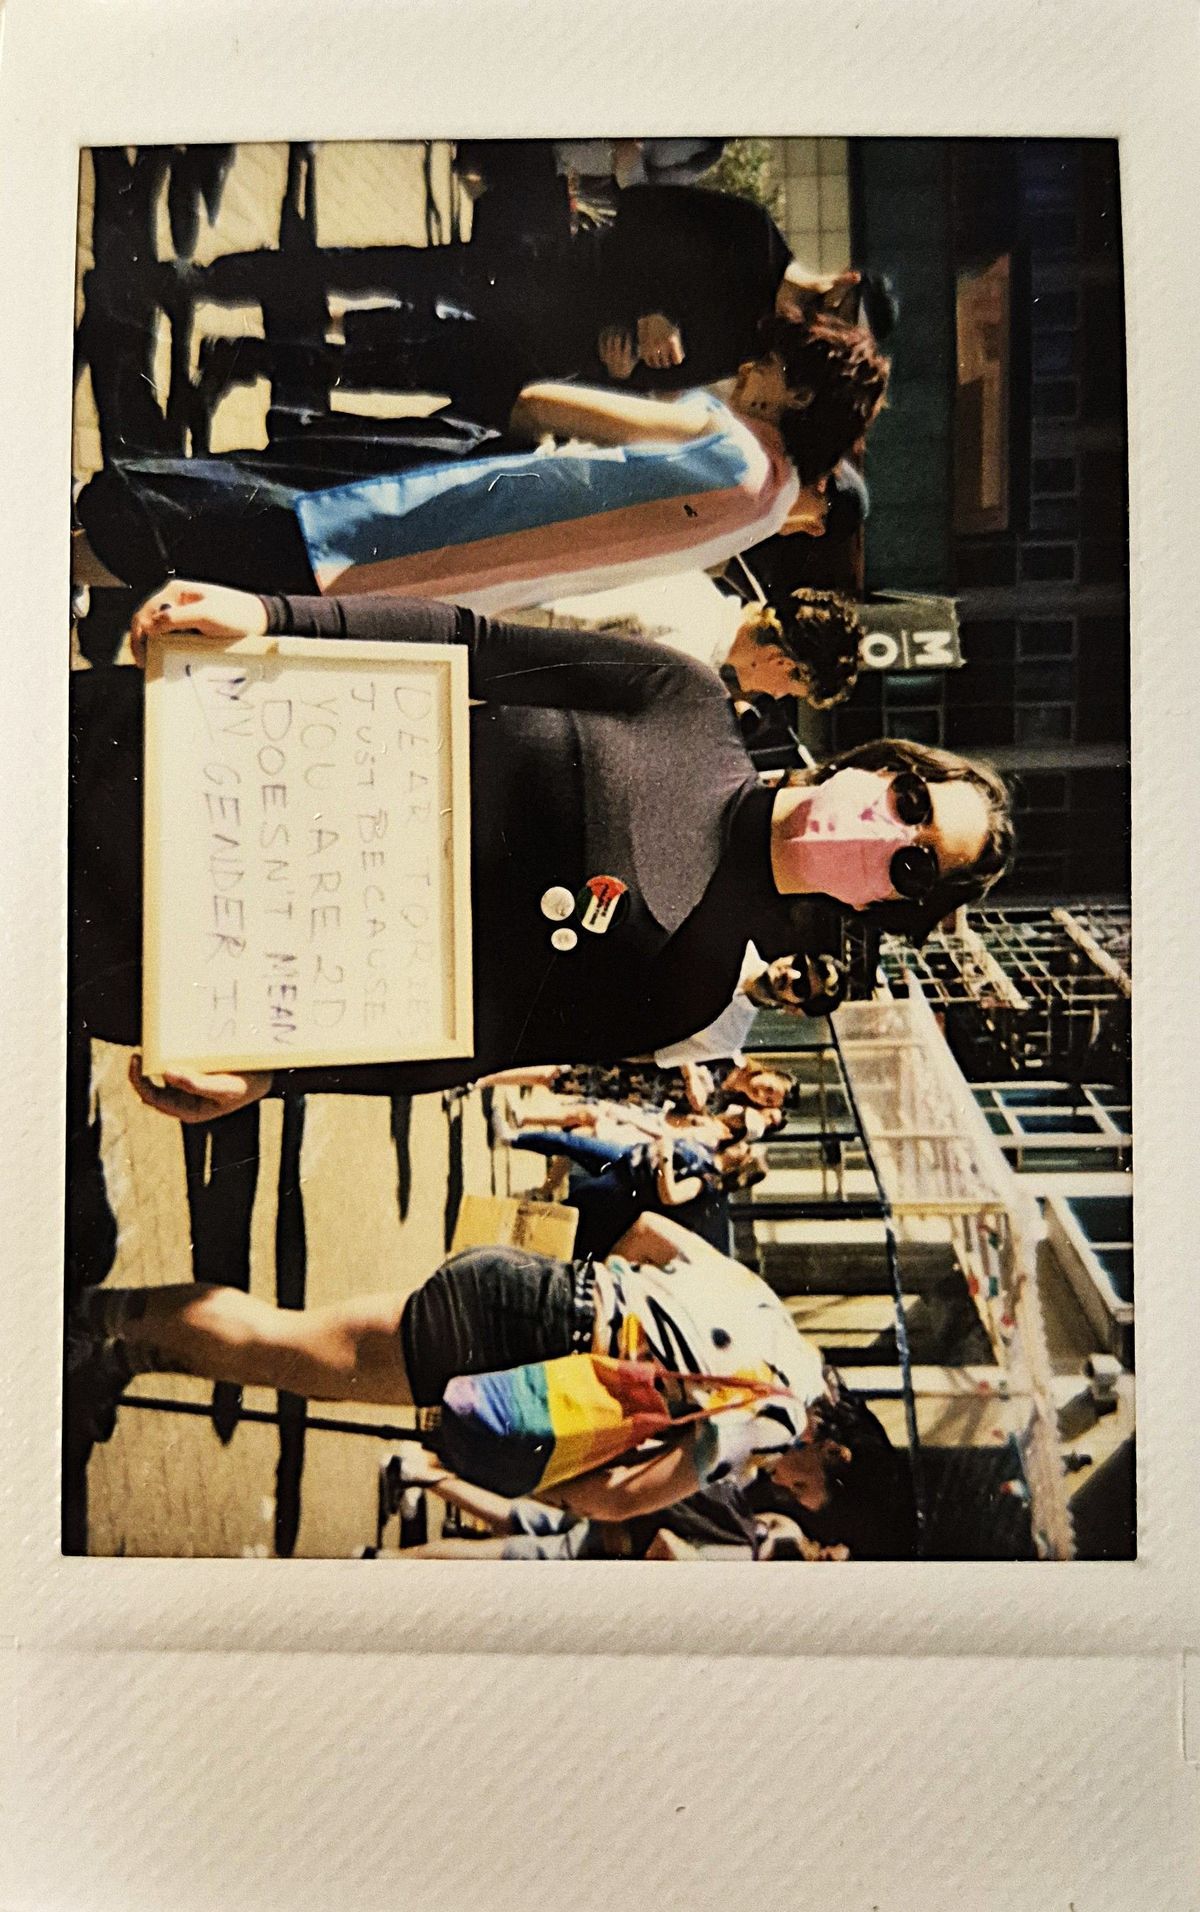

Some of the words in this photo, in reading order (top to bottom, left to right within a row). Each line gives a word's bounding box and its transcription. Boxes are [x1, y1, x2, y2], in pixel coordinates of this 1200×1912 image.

[206, 675, 254, 737] MY
[300, 697, 340, 790] YOU
[351, 682, 375, 788] JUST
[394, 686, 433, 824] DEAR
[203, 762, 247, 963] GENDER
[257, 699, 294, 920] DOESN'T
[308, 828, 342, 943] ARE
[356, 809, 388, 1026] BECAUSE
[207, 980, 239, 1042] IS
[262, 952, 298, 1044] MEAN
[310, 954, 347, 1028] 2D
